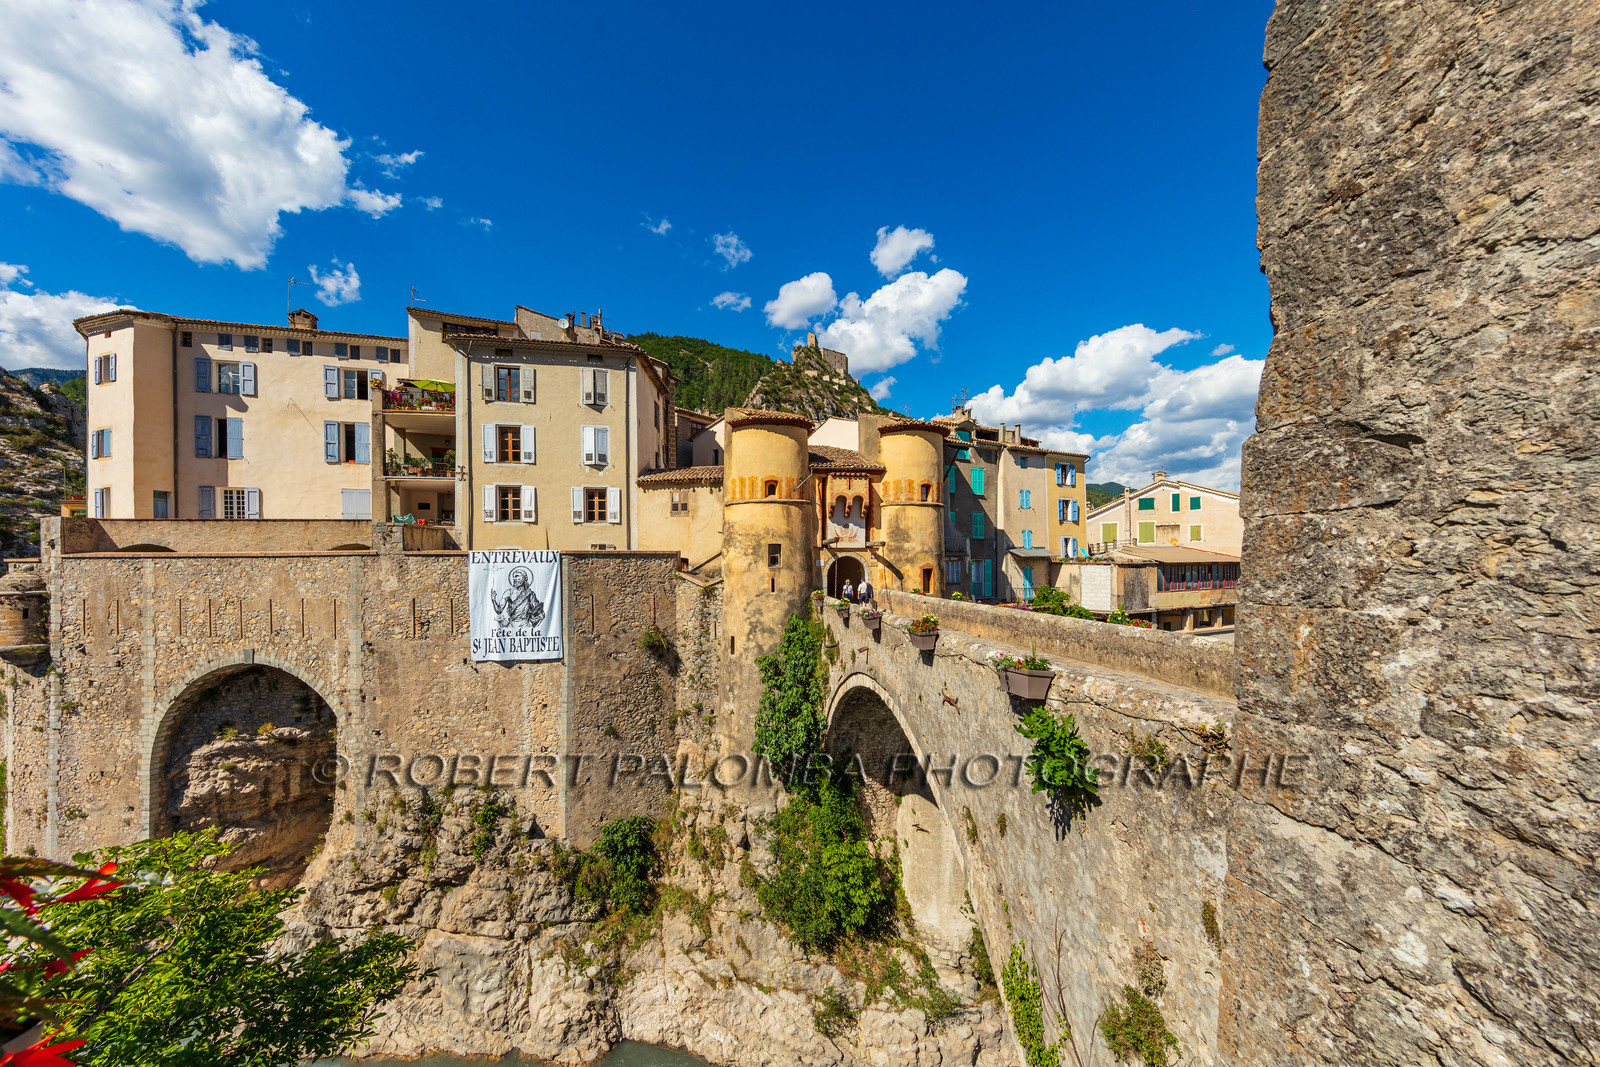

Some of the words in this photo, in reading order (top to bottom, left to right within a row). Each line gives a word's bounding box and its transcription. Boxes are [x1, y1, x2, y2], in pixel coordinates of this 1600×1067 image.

[471, 551, 560, 564] ENTREVAUX
[491, 628, 512, 637] Fête
[515, 628, 527, 637] de
[531, 628, 542, 637] la
[472, 638, 481, 654] St
[483, 637, 506, 658] JEAN
[509, 636, 560, 653] BAPTISTE
